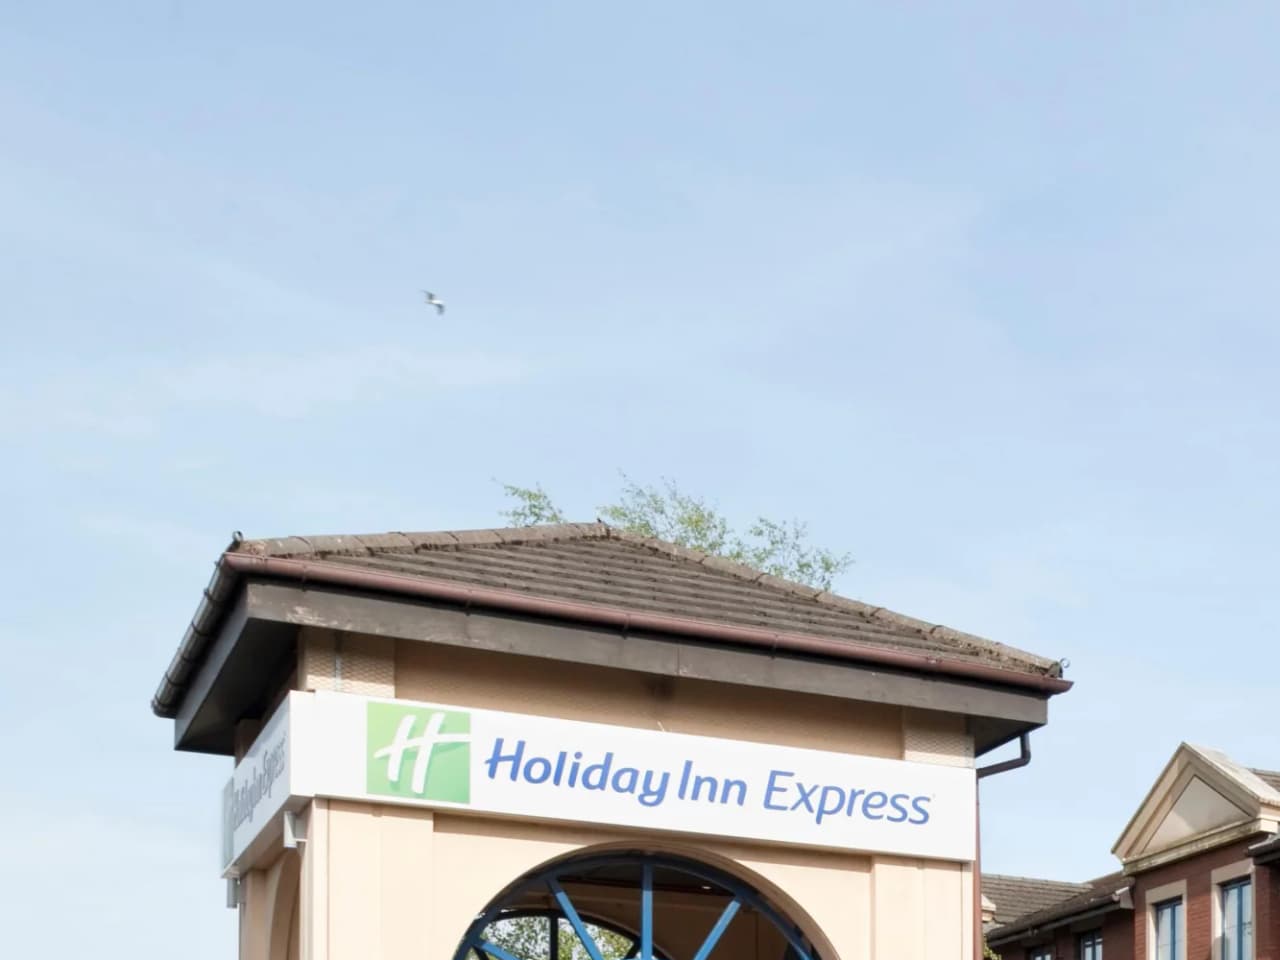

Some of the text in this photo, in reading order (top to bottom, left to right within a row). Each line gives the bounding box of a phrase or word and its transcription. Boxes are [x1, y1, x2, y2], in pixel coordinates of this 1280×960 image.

[485, 738, 670, 807] Holiday
[677, 760, 748, 806] Inn
[763, 769, 931, 825] Express
